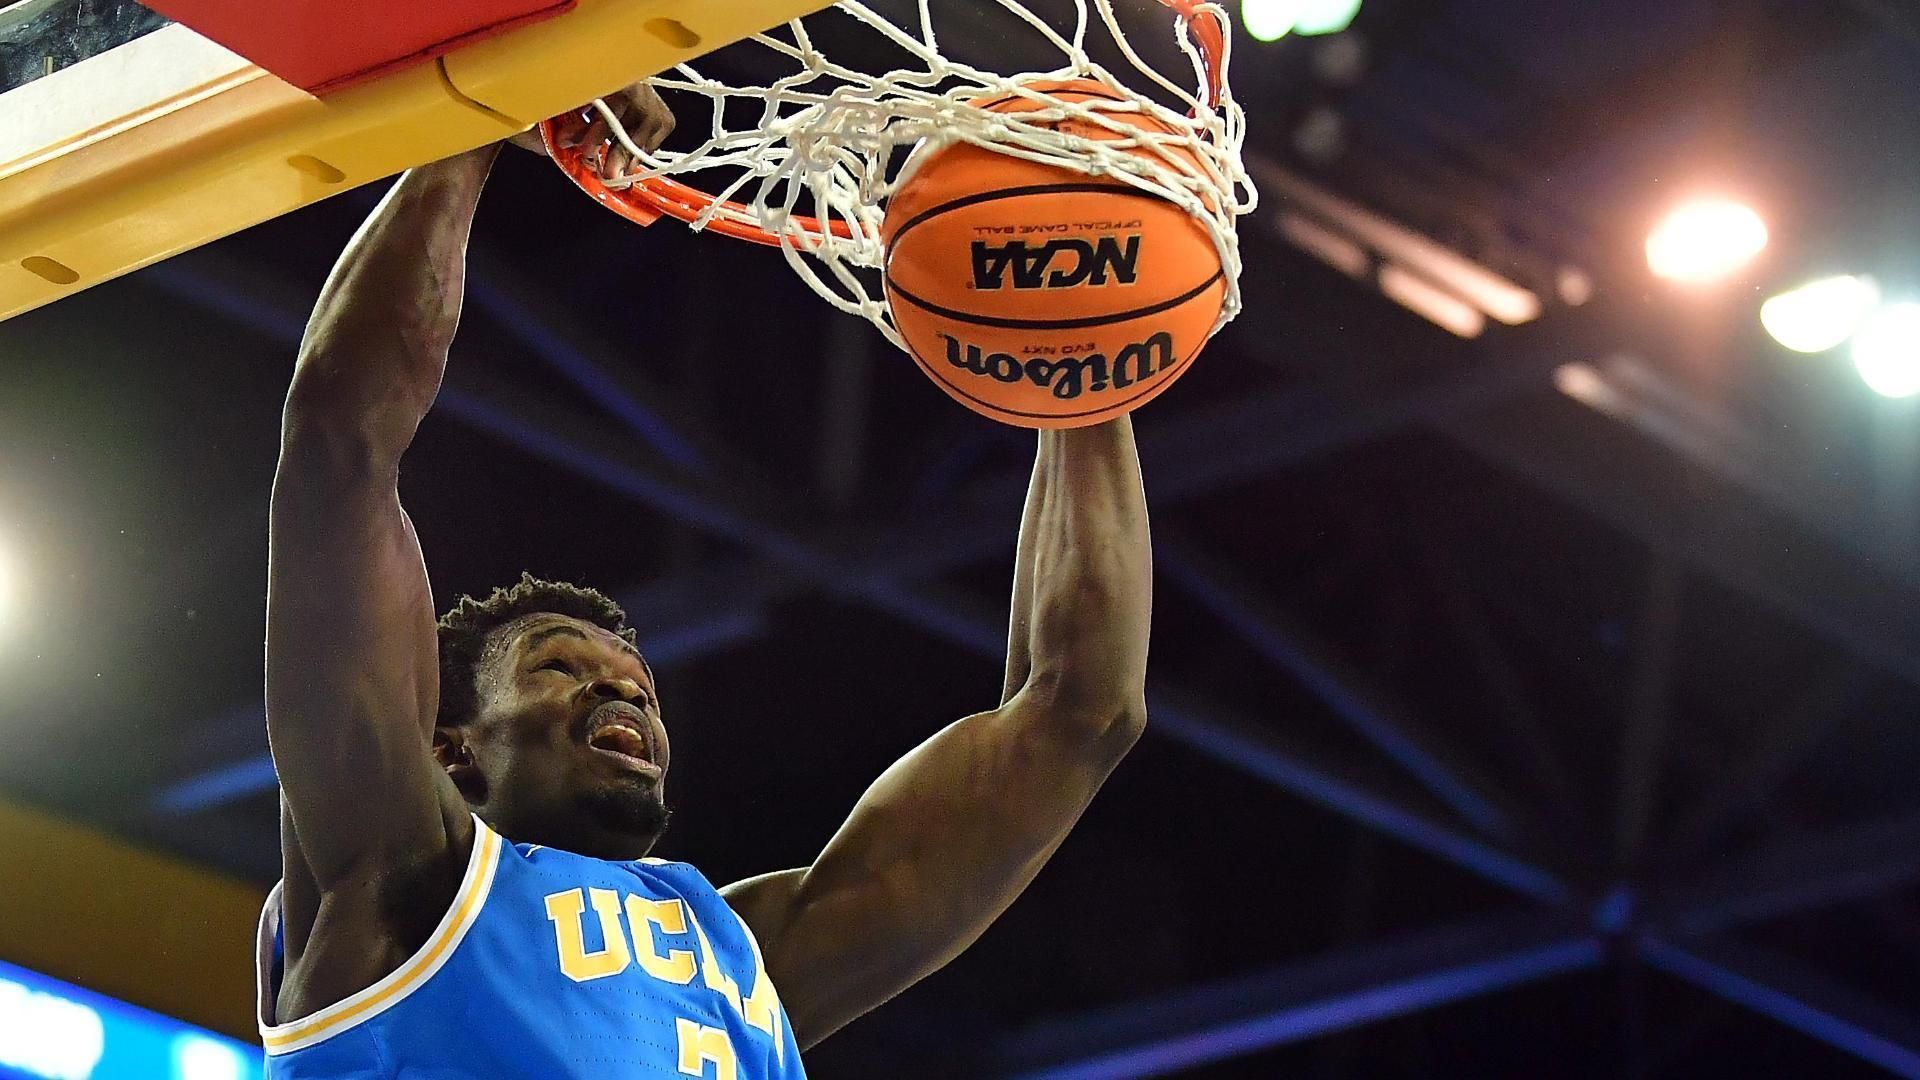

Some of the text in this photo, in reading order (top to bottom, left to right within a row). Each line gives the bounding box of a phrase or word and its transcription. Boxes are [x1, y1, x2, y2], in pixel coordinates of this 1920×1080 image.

[973, 219, 1143, 235] OFFICIAL GAME BALL
[971, 234, 1142, 290] NCAA
[943, 332, 1176, 399] Wilson
[1022, 342, 1096, 355] EVO NXT
